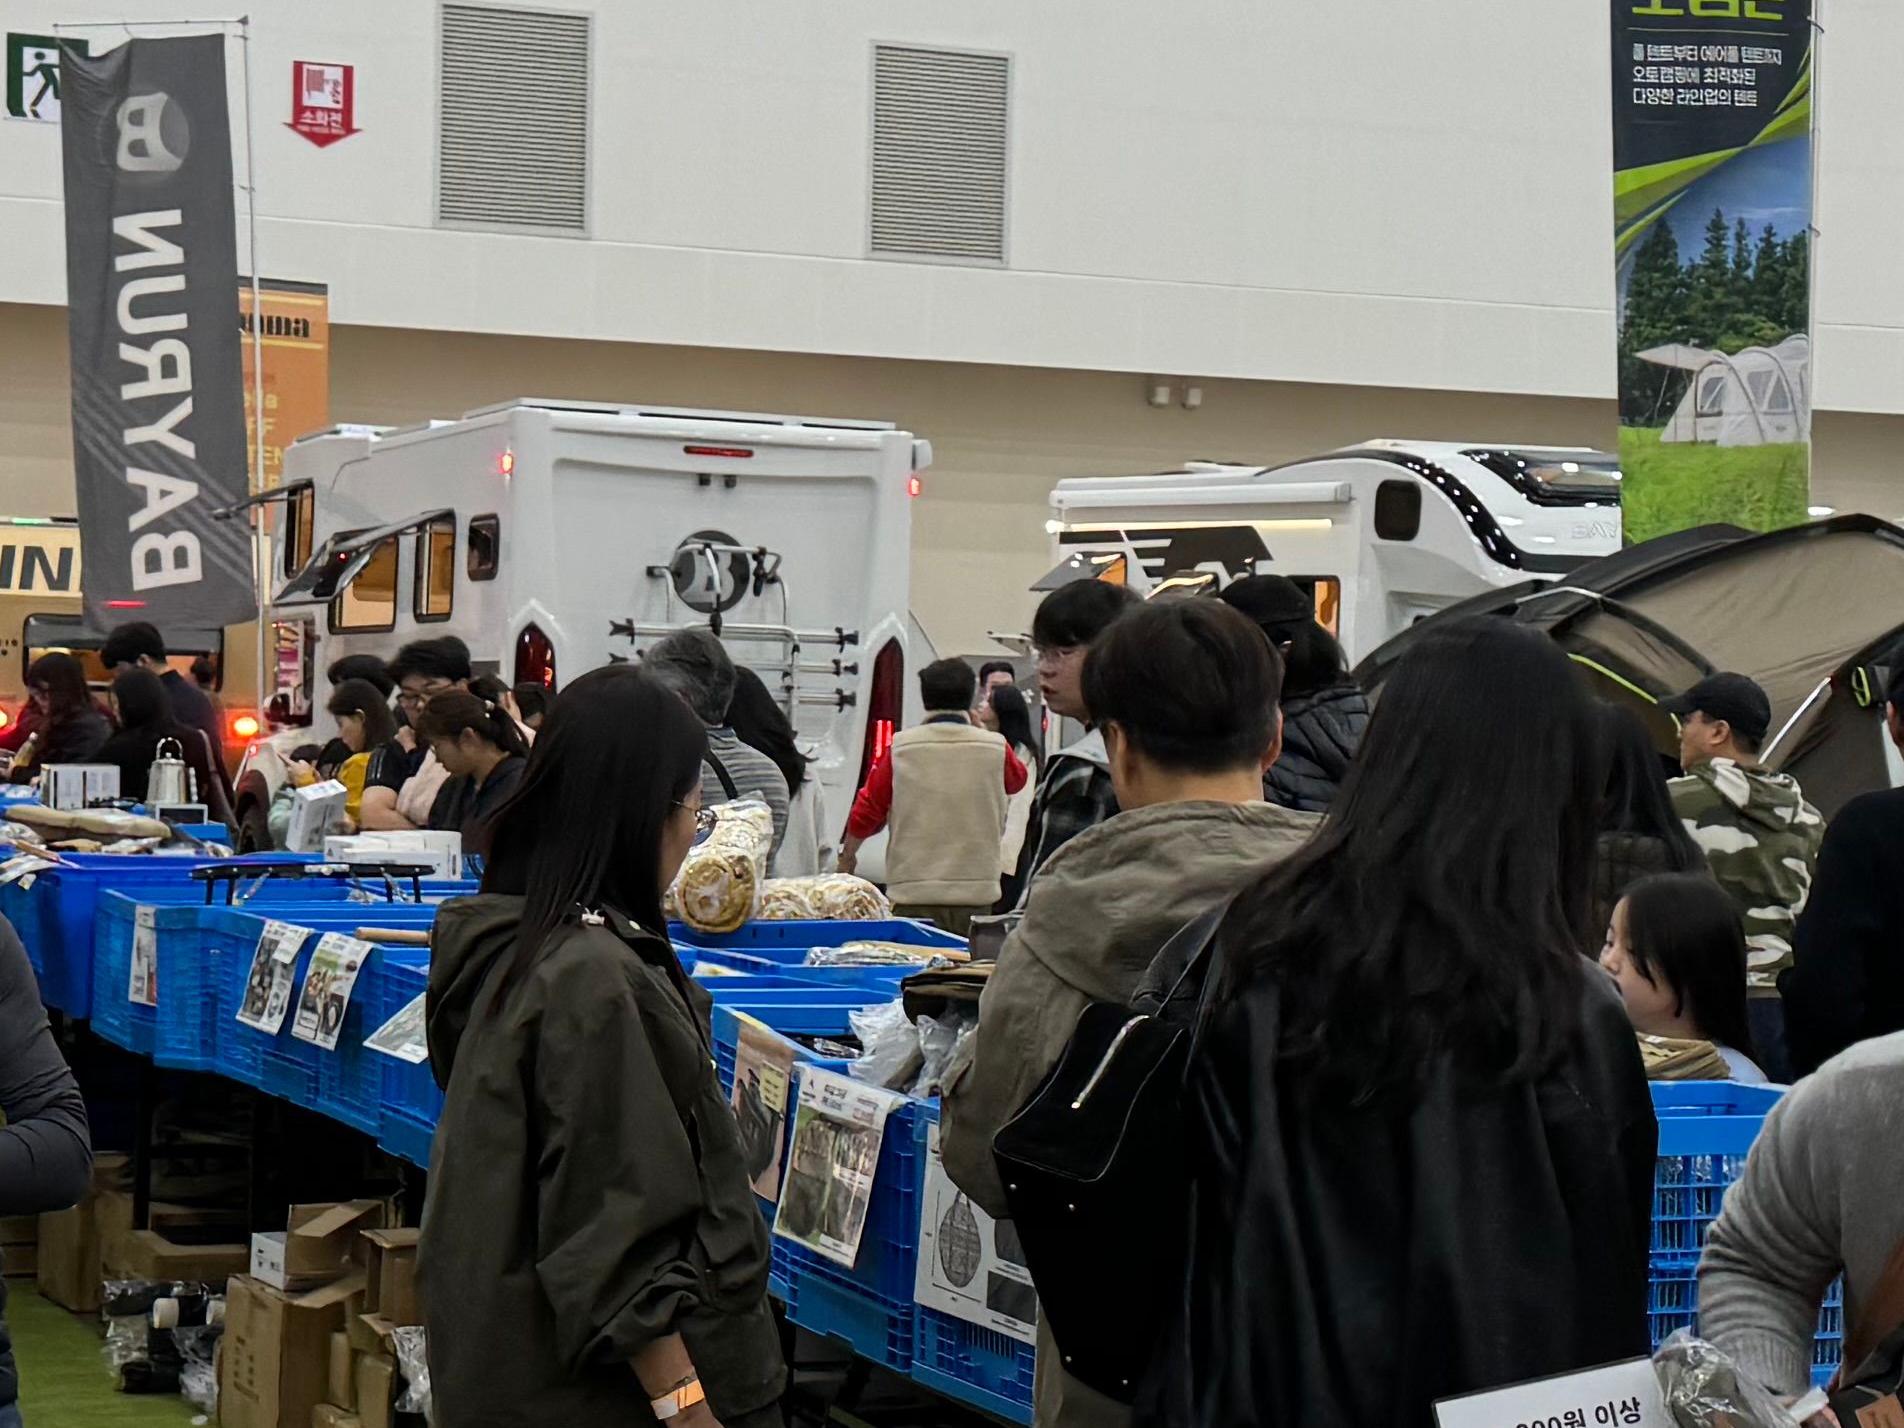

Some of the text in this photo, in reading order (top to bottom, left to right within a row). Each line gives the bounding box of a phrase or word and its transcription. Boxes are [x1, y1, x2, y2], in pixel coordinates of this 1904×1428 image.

[1633, 88, 1674, 105] 다양한
[1677, 89, 1731, 105] 라인업의
[299, 111, 343, 126] 소화전
[1595, 1397, 1642, 1427] 이상
